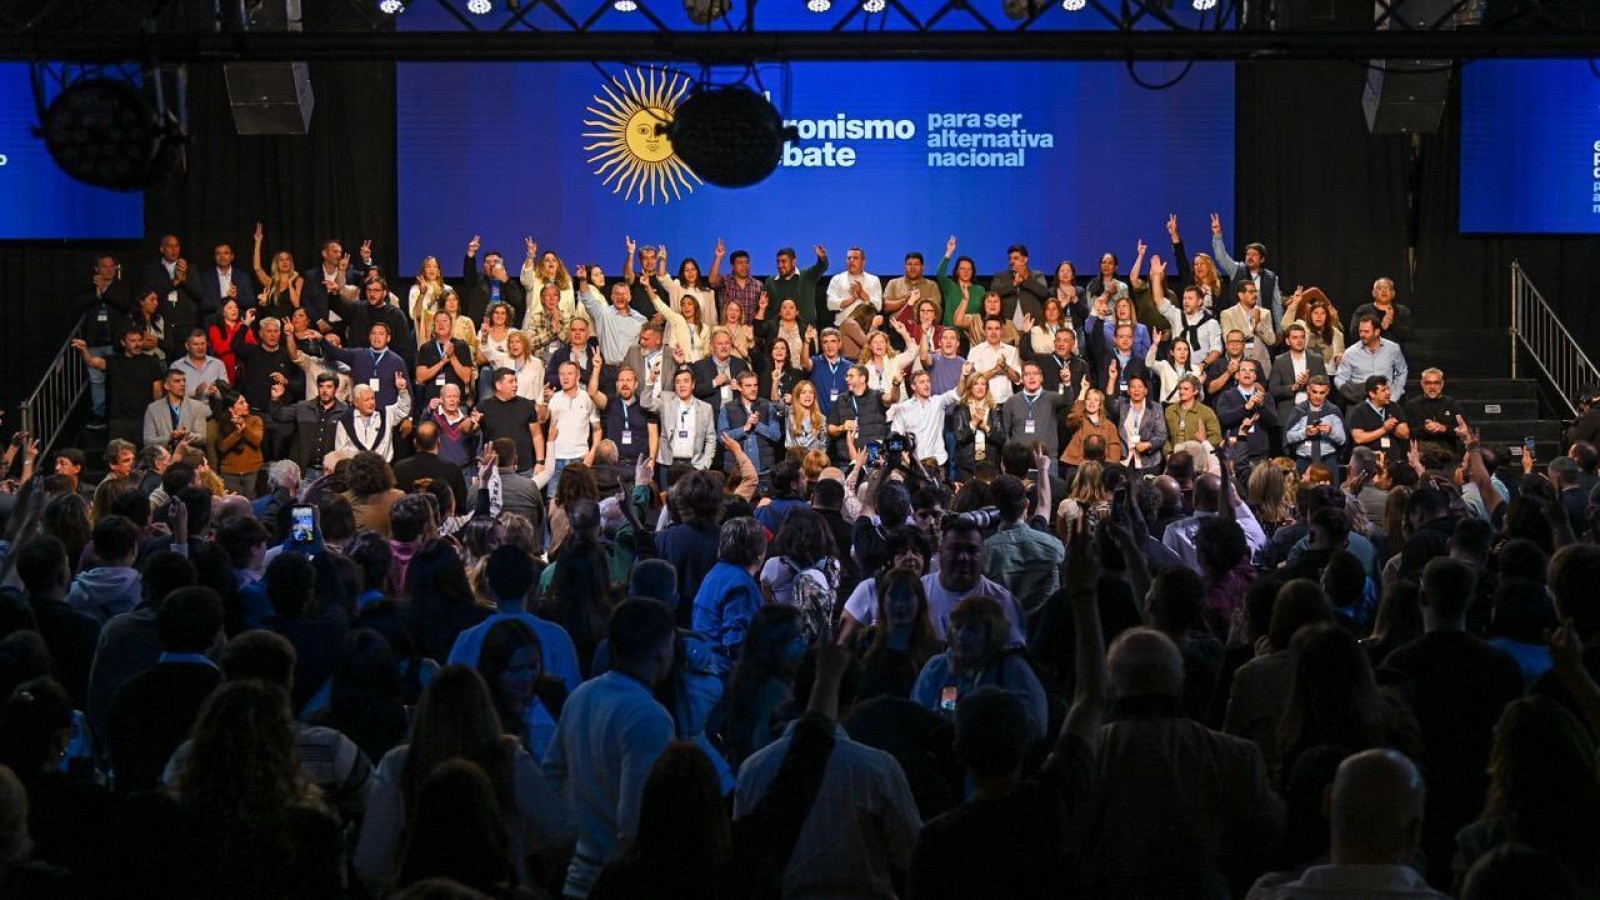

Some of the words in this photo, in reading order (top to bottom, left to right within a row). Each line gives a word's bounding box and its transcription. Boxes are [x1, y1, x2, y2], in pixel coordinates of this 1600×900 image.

[783, 113, 915, 139] ronismo
[928, 112, 982, 129] para
[983, 112, 1022, 127] ser
[927, 129, 1053, 148] alternativa
[778, 141, 856, 167] bate
[928, 149, 1025, 167] nacional
